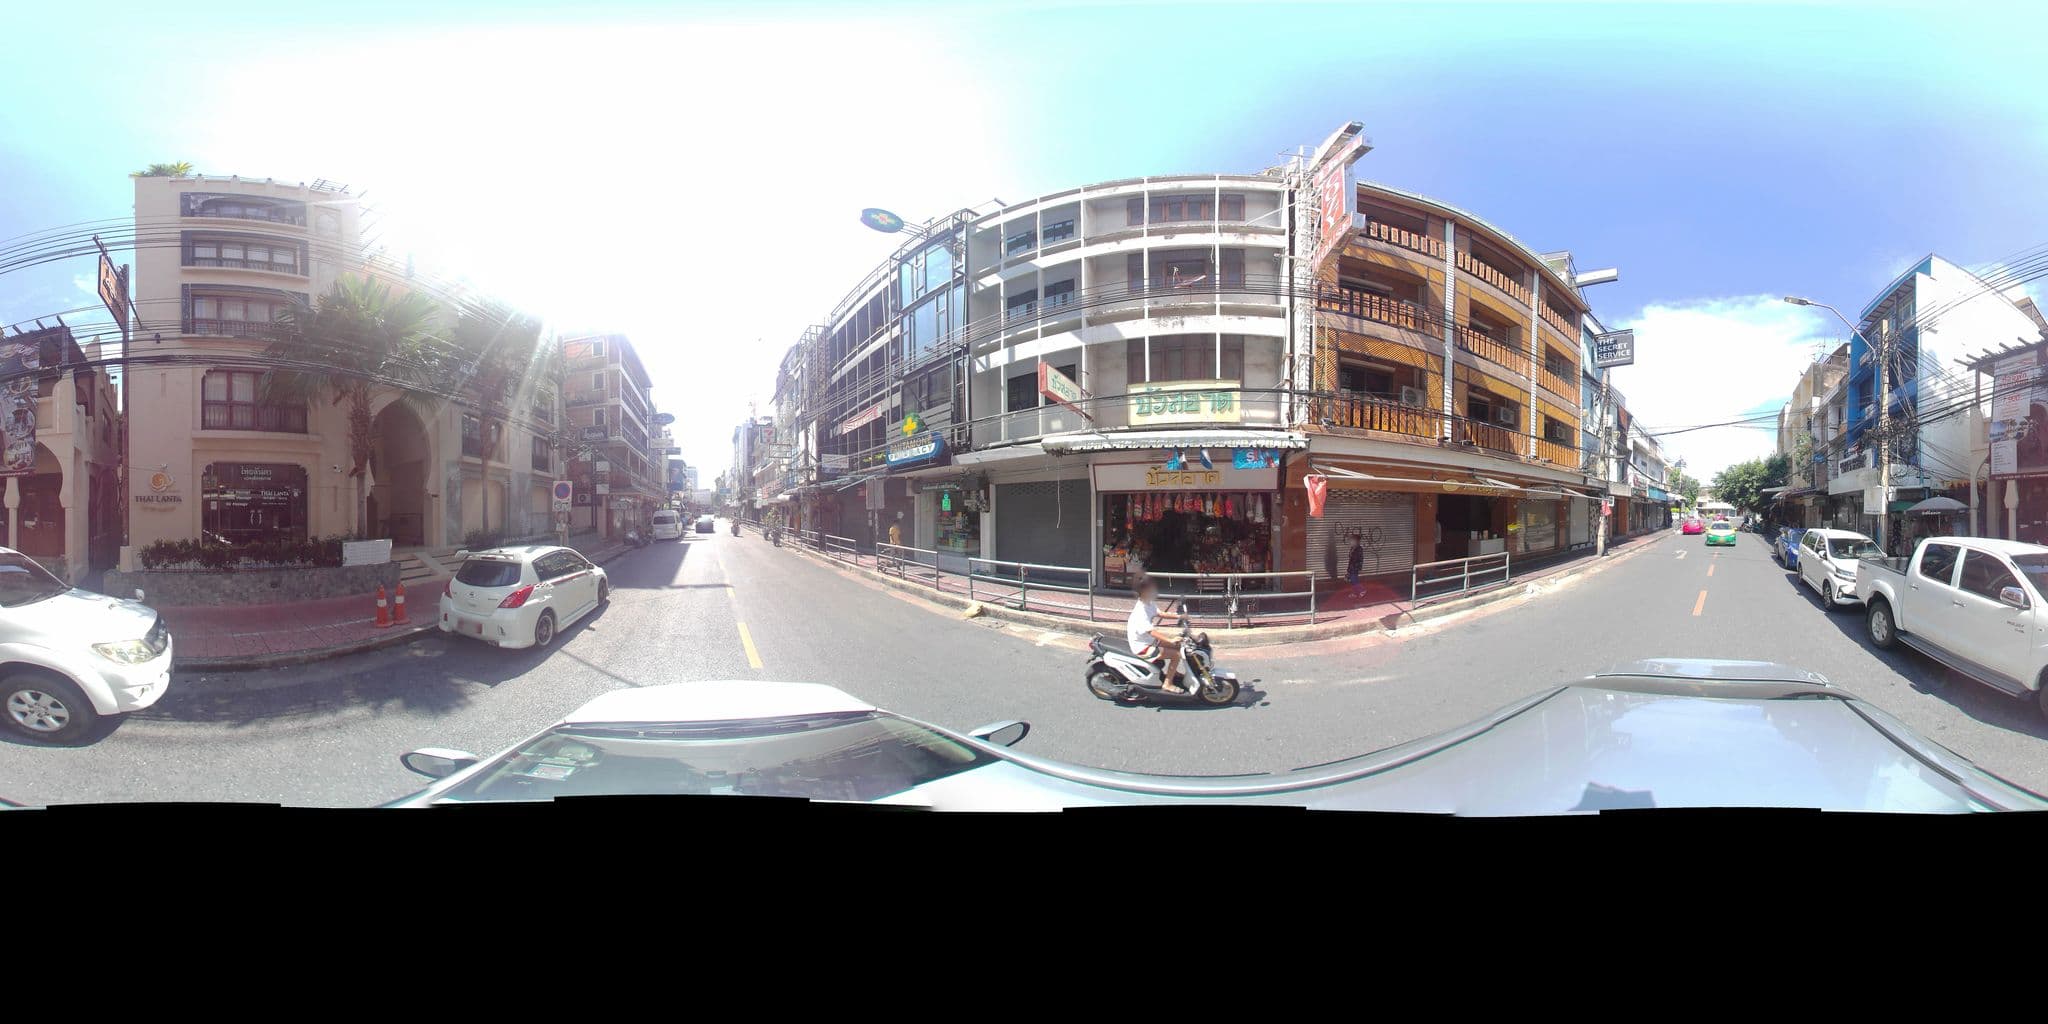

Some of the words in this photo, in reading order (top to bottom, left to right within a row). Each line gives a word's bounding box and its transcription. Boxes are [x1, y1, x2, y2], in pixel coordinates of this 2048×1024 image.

[1599, 338, 1615, 346] THE
[1598, 342, 1628, 352] SECRET
[1598, 349, 1631, 359] SERVICE
[135, 495, 154, 503] THAI
[156, 495, 182, 503] LANTA
